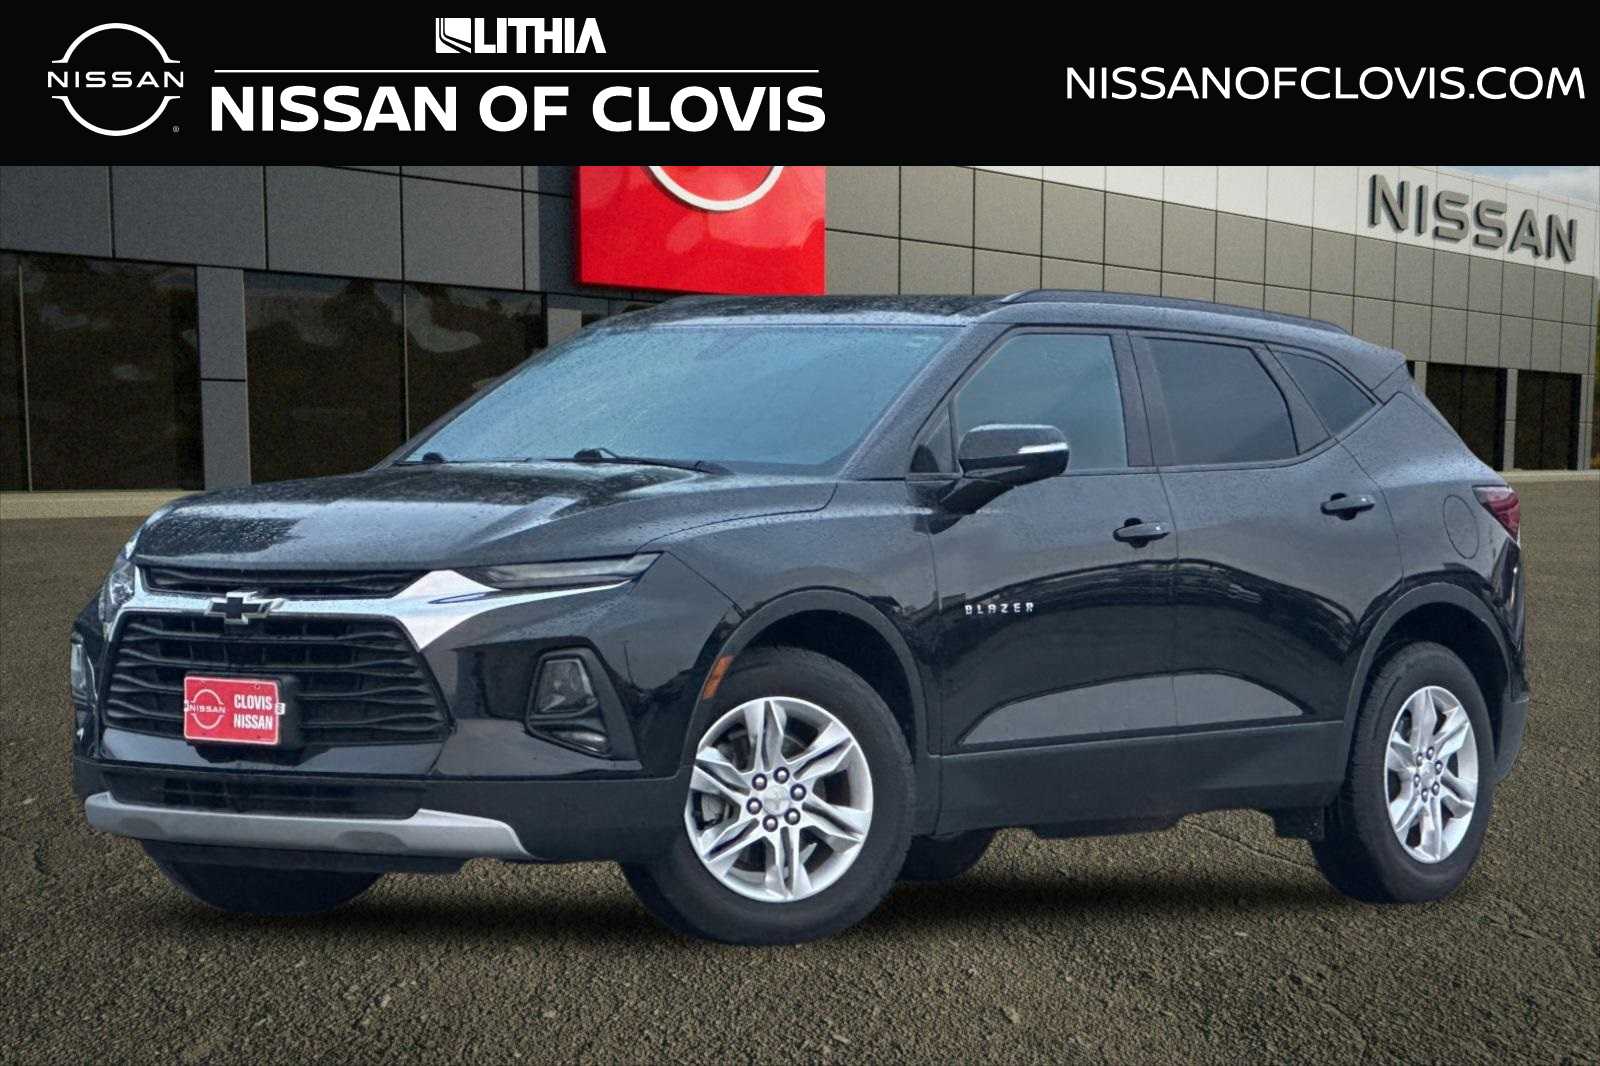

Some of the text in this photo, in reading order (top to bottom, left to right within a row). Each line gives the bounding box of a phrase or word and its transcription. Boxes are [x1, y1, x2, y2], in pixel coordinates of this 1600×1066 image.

[1368, 174, 1578, 263] NISSAN
[964, 602, 1034, 615] BLAZER
[189, 704, 226, 714] NISSAN
[233, 694, 273, 710] CLOVIS
[233, 714, 273, 730] NISSAN
